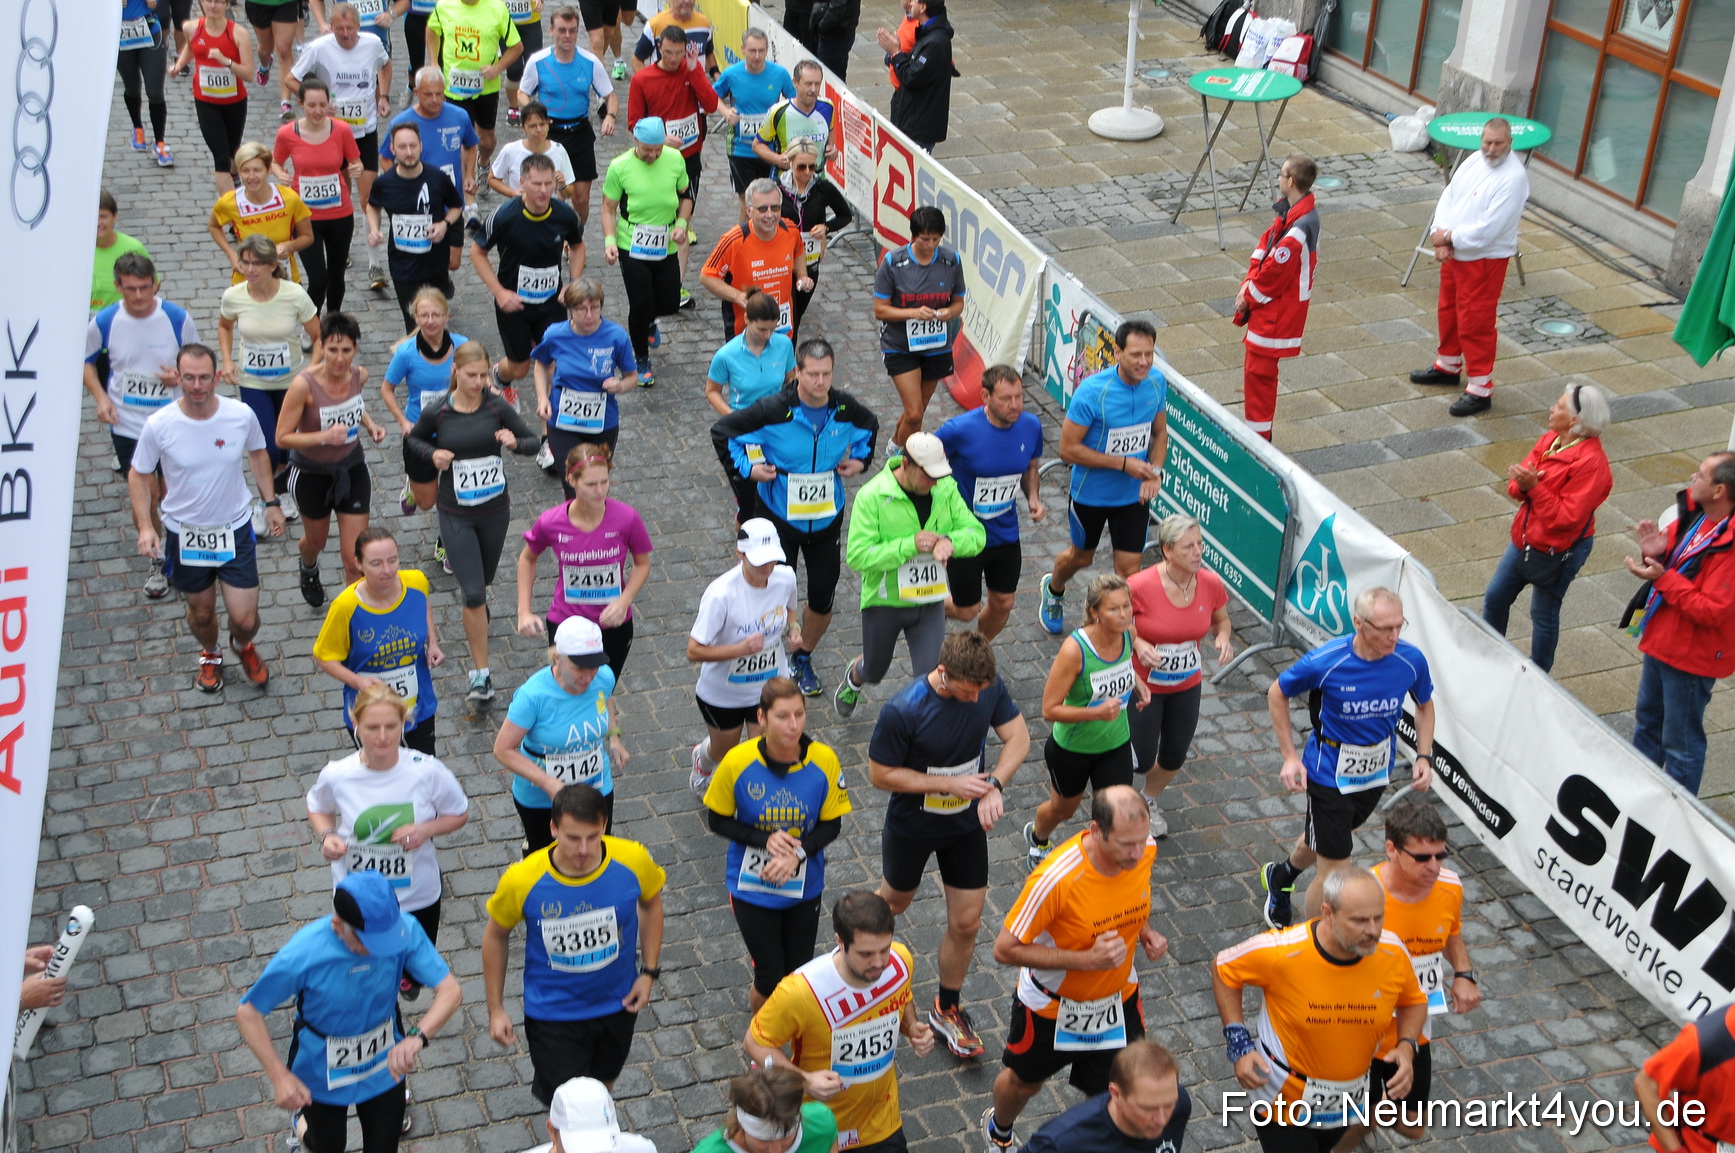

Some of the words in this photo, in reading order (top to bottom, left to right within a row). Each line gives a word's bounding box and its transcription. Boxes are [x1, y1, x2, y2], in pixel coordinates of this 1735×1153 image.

[120, 25, 145, 39] 2717
[455, 26, 480, 34] Müller
[207, 75, 230, 87] 608
[336, 72, 360, 80] Allianz
[453, 76, 481, 88] 2073
[341, 105, 362, 117] 173
[304, 183, 338, 198] 2359
[242, 217, 263, 227] MAX
[265, 211, 288, 222] BÖGL
[397, 224, 429, 238] 2725
[635, 232, 665, 247] 2741
[752, 265, 789, 278] SportScheck
[523, 276, 555, 289] 2495
[911, 319, 943, 335] 2189
[916, 337, 939, 345] Christine
[248, 352, 284, 367] 2671
[127, 380, 168, 396] 2672
[564, 400, 602, 418] 2267
[0, 318, 40, 523] BKK
[1111, 434, 1147, 453] 2824
[459, 468, 500, 488] 2122
[1170, 445, 1229, 514] Sicherheit
[799, 484, 826, 502] 624
[979, 485, 1016, 502] 2177
[1173, 477, 1212, 526] Event!
[185, 532, 227, 549] 2691
[569, 572, 615, 586] 2494
[909, 563, 938, 584] 340
[1224, 561, 1243, 588] 6352
[580, 589, 606, 597] Marina
[916, 586, 934, 595] Klaus
[736, 651, 776, 673] 2664
[1159, 651, 1197, 671] 2813
[0, 566, 29, 796] Audi
[1097, 673, 1133, 700] 2893
[1342, 697, 1399, 714] SYSCAD
[553, 755, 598, 783] 2142
[1343, 752, 1386, 775] 2354
[1435, 754, 1452, 778] die
[1452, 769, 1501, 828] verbinden
[352, 854, 406, 876] 2488
[1092, 916, 1112, 928] Verein
[1113, 913, 1123, 921] der
[1124, 902, 1147, 915] Notärzte
[1534, 845, 1683, 995] stadtwerke
[551, 925, 611, 954] 3385
[1308, 1002, 1332, 1010] Verein
[1333, 1002, 1345, 1010] der
[1347, 1002, 1377, 1011] Notärzte
[1064, 1004, 1118, 1032] 2770
[1305, 1017, 1331, 1025] Altdorf
[1337, 1017, 1362, 1025] Feucht
[833, 1032, 858, 1042] PARTL
[858, 1022, 889, 1036] Neumarkt
[335, 1027, 387, 1068] 2141
[839, 1029, 894, 1063] 2453
[853, 1062, 881, 1076] Marco
